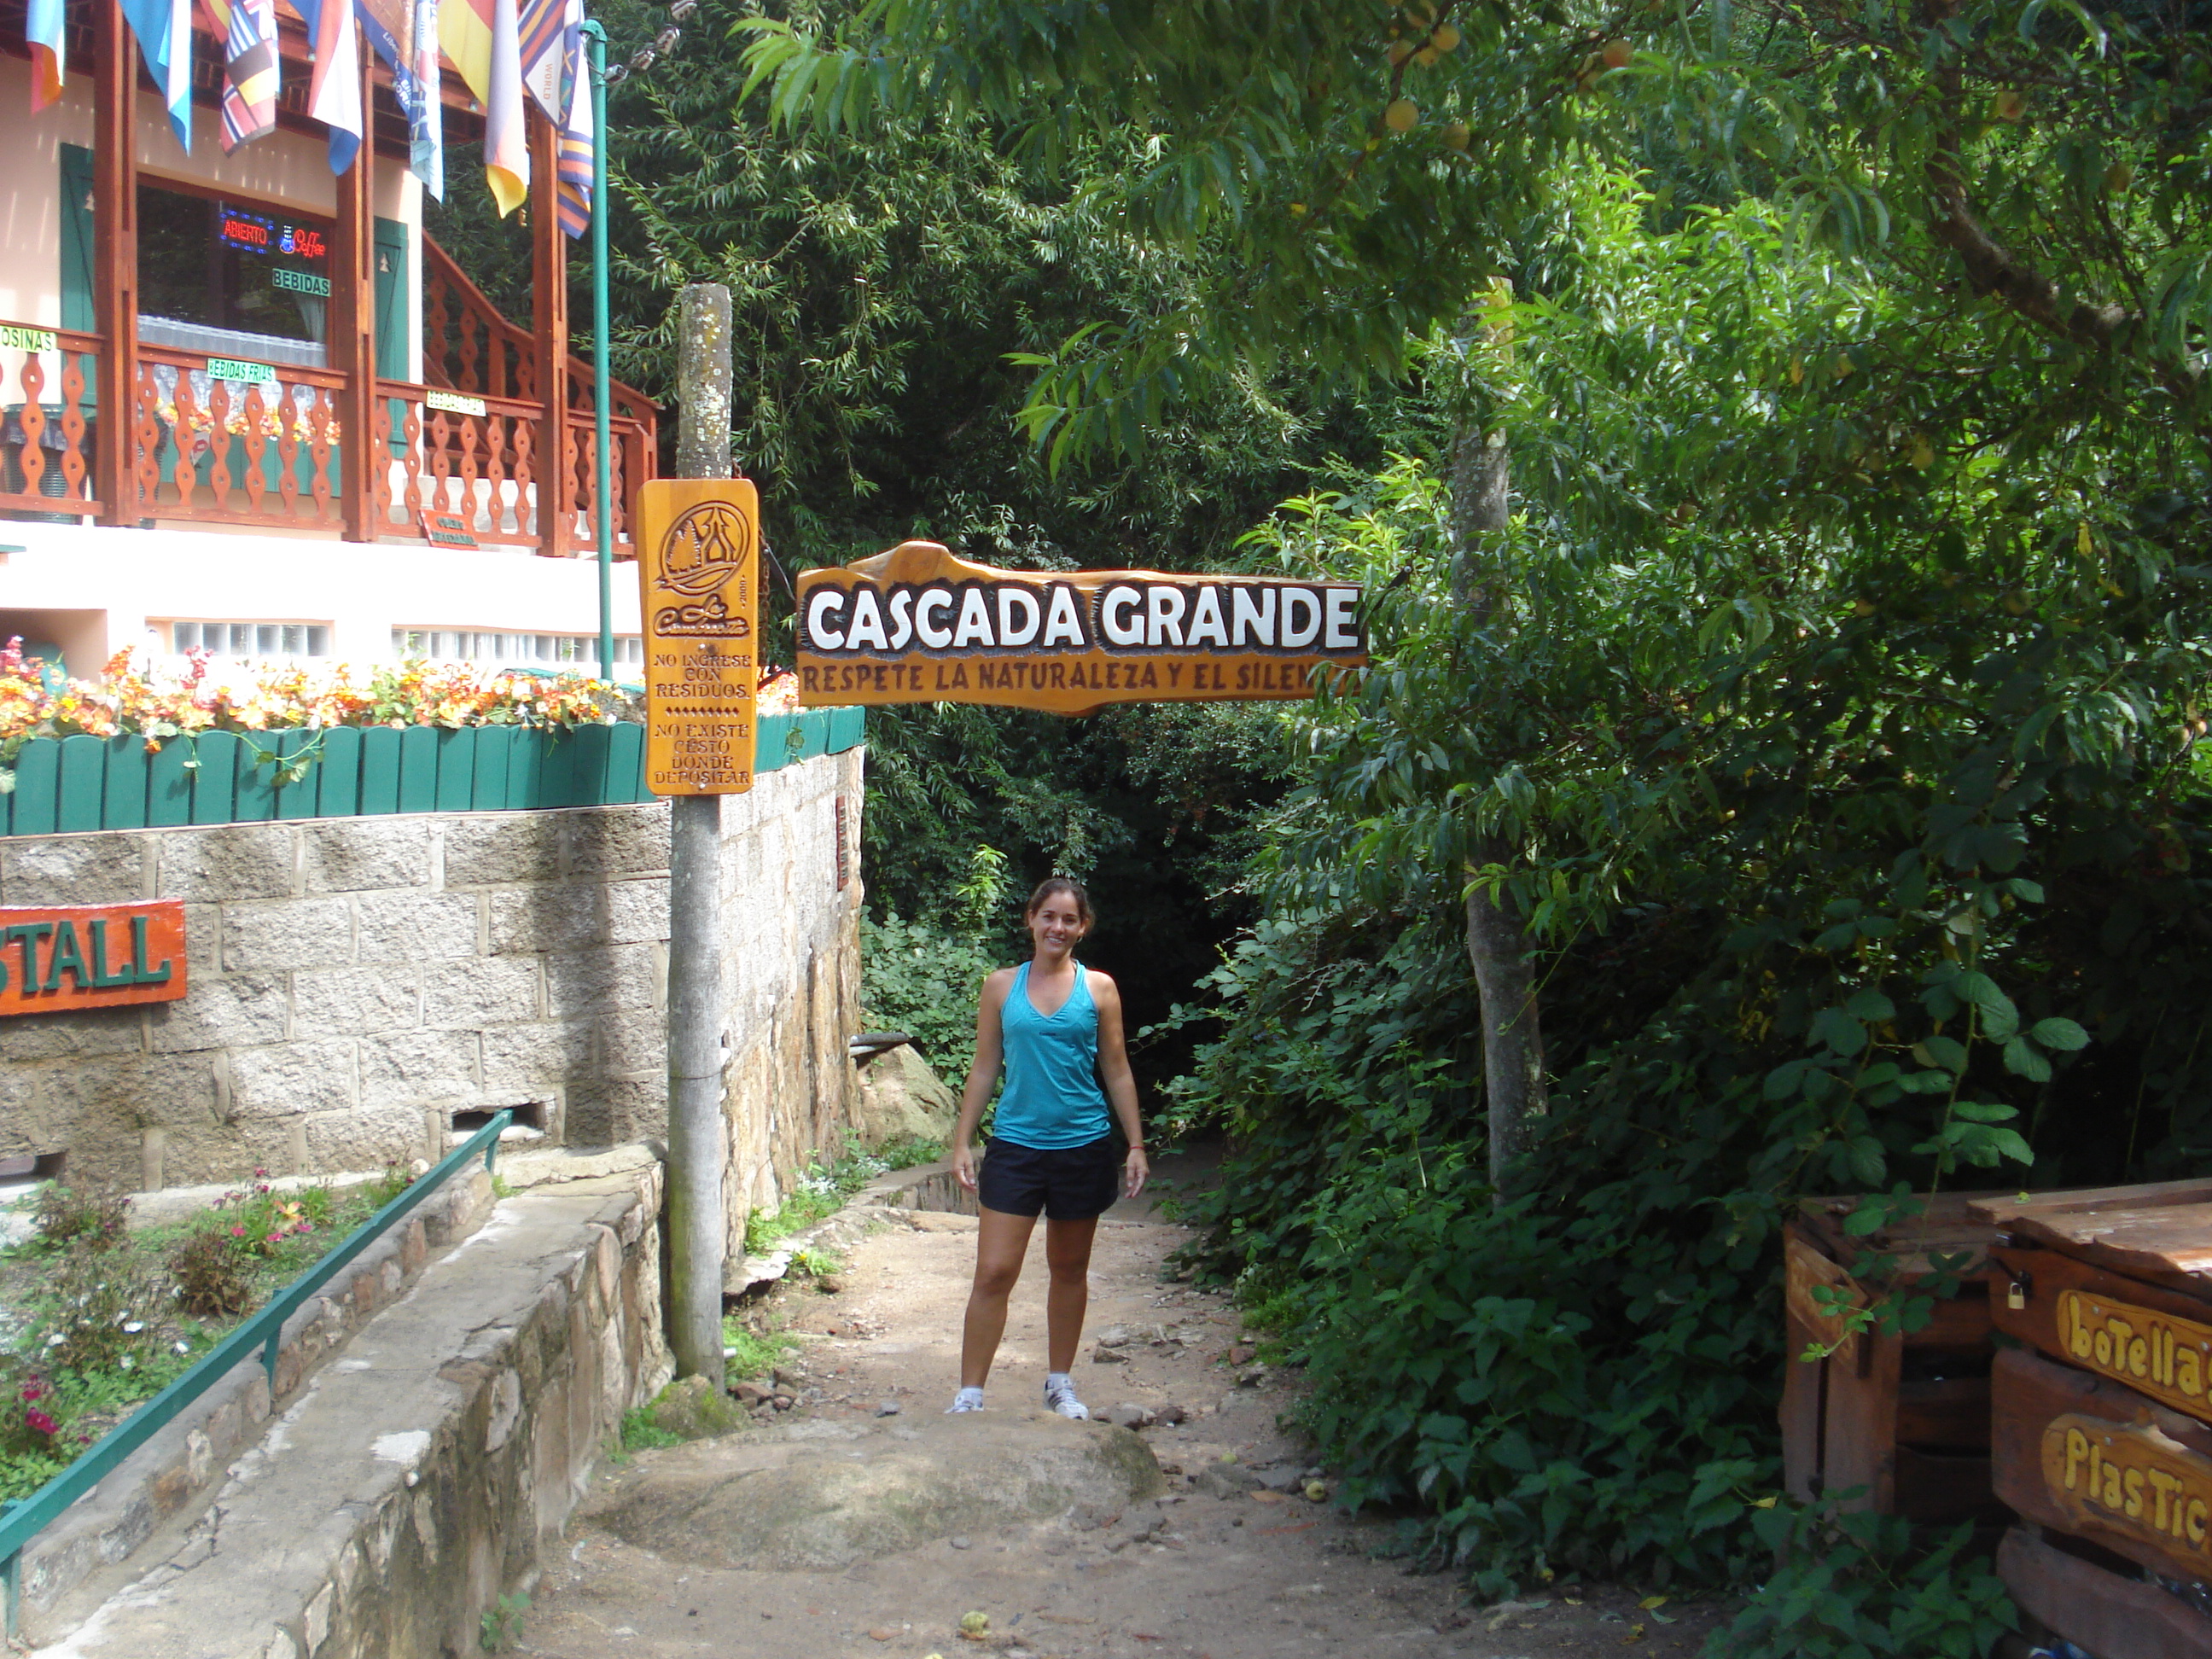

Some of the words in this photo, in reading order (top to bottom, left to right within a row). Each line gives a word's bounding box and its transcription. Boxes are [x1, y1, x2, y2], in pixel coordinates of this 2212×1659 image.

[544, 63, 553, 100] WORLD
[224, 219, 268, 246] ABIERTO
[294, 229, 326, 258] Coffee
[273, 270, 330, 295] BEBIDAS
[208, 359, 246, 380] BEBIDAS
[247, 365, 273, 382] FRIAS
[807, 585, 1086, 650] CASCADA
[1102, 585, 1359, 649] GRANDE
[654, 655, 677, 667] NO
[682, 655, 752, 668] INGRESE
[685, 668, 721, 682] CON
[802, 663, 924, 693] RESPETE
[935, 662, 969, 691] LA
[979, 661, 1158, 691] NATURALEZA
[1167, 662, 1184, 689] Y
[1192, 663, 1227, 690] EL
[655, 684, 751, 699] RESIDUOS.
[654, 724, 680, 738] NO
[686, 724, 748, 738] EXISTE
[674, 739, 730, 754] CESTO
[672, 756, 734, 770] DONDE
[655, 771, 750, 784] DEPOSITAR
